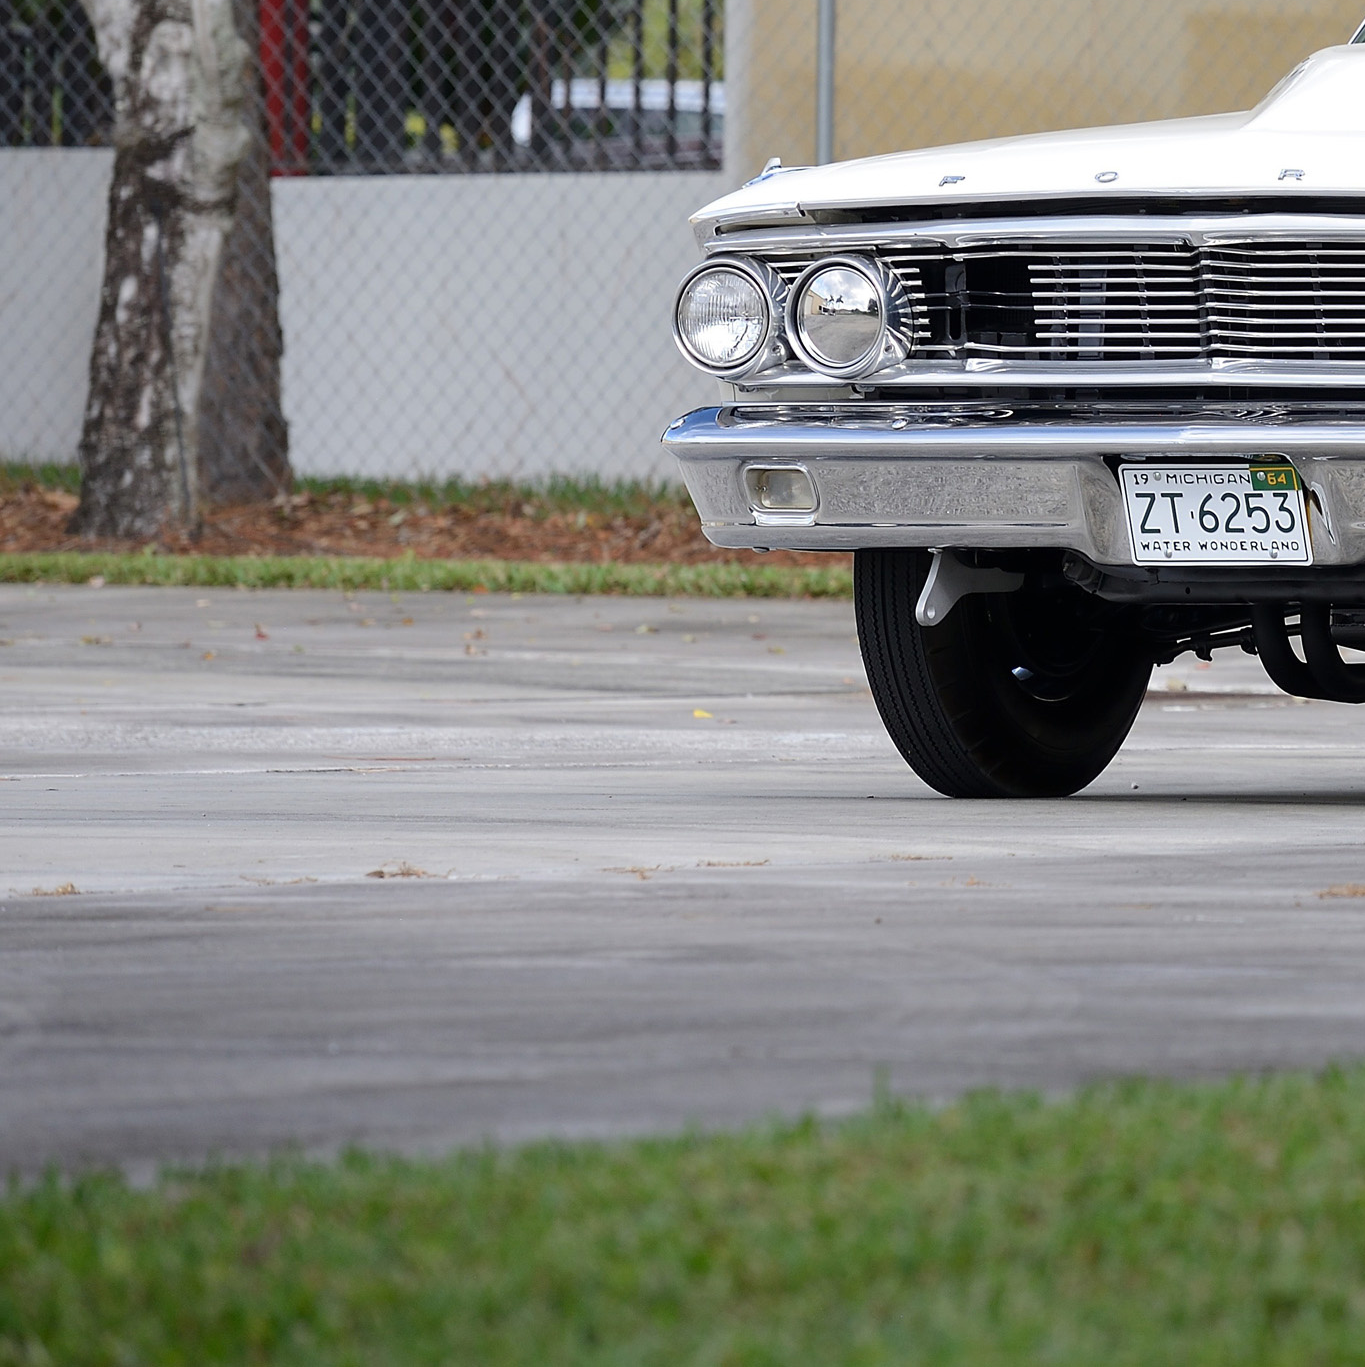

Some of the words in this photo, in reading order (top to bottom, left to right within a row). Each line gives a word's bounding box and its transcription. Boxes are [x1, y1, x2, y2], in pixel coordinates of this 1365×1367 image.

[1133, 473, 1149, 485] 19
[1166, 473, 1250, 485] MICHIGAN
[1266, 473, 1287, 485] 64
[1140, 541, 1191, 552] WATER
[1198, 541, 1300, 552] WONDERLAND
